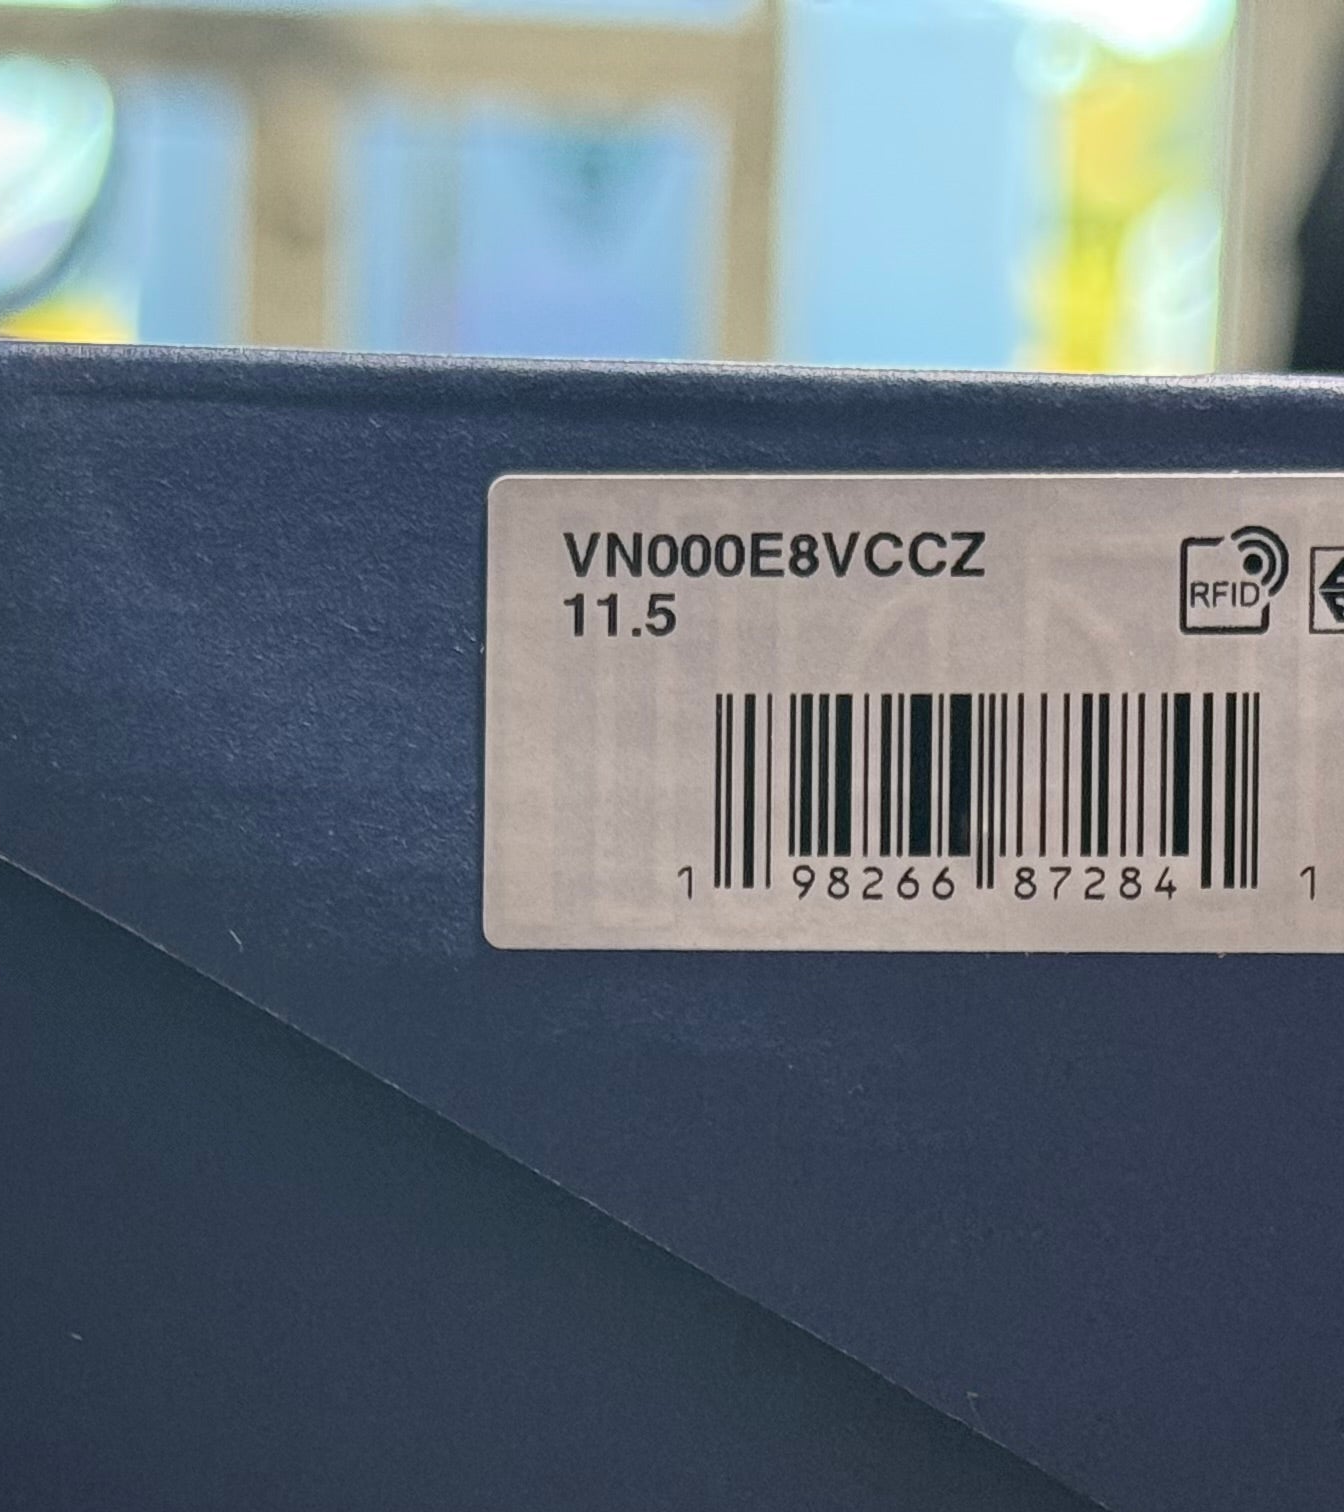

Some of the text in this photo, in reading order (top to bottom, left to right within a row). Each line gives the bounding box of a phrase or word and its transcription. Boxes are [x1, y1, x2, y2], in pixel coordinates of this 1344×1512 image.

[562, 530, 986, 578] VN000E8VCCZ
[1189, 580, 1260, 608] RFID
[563, 592, 677, 638] 11.5
[677, 864, 1316, 900] 1 98266 87284 1
